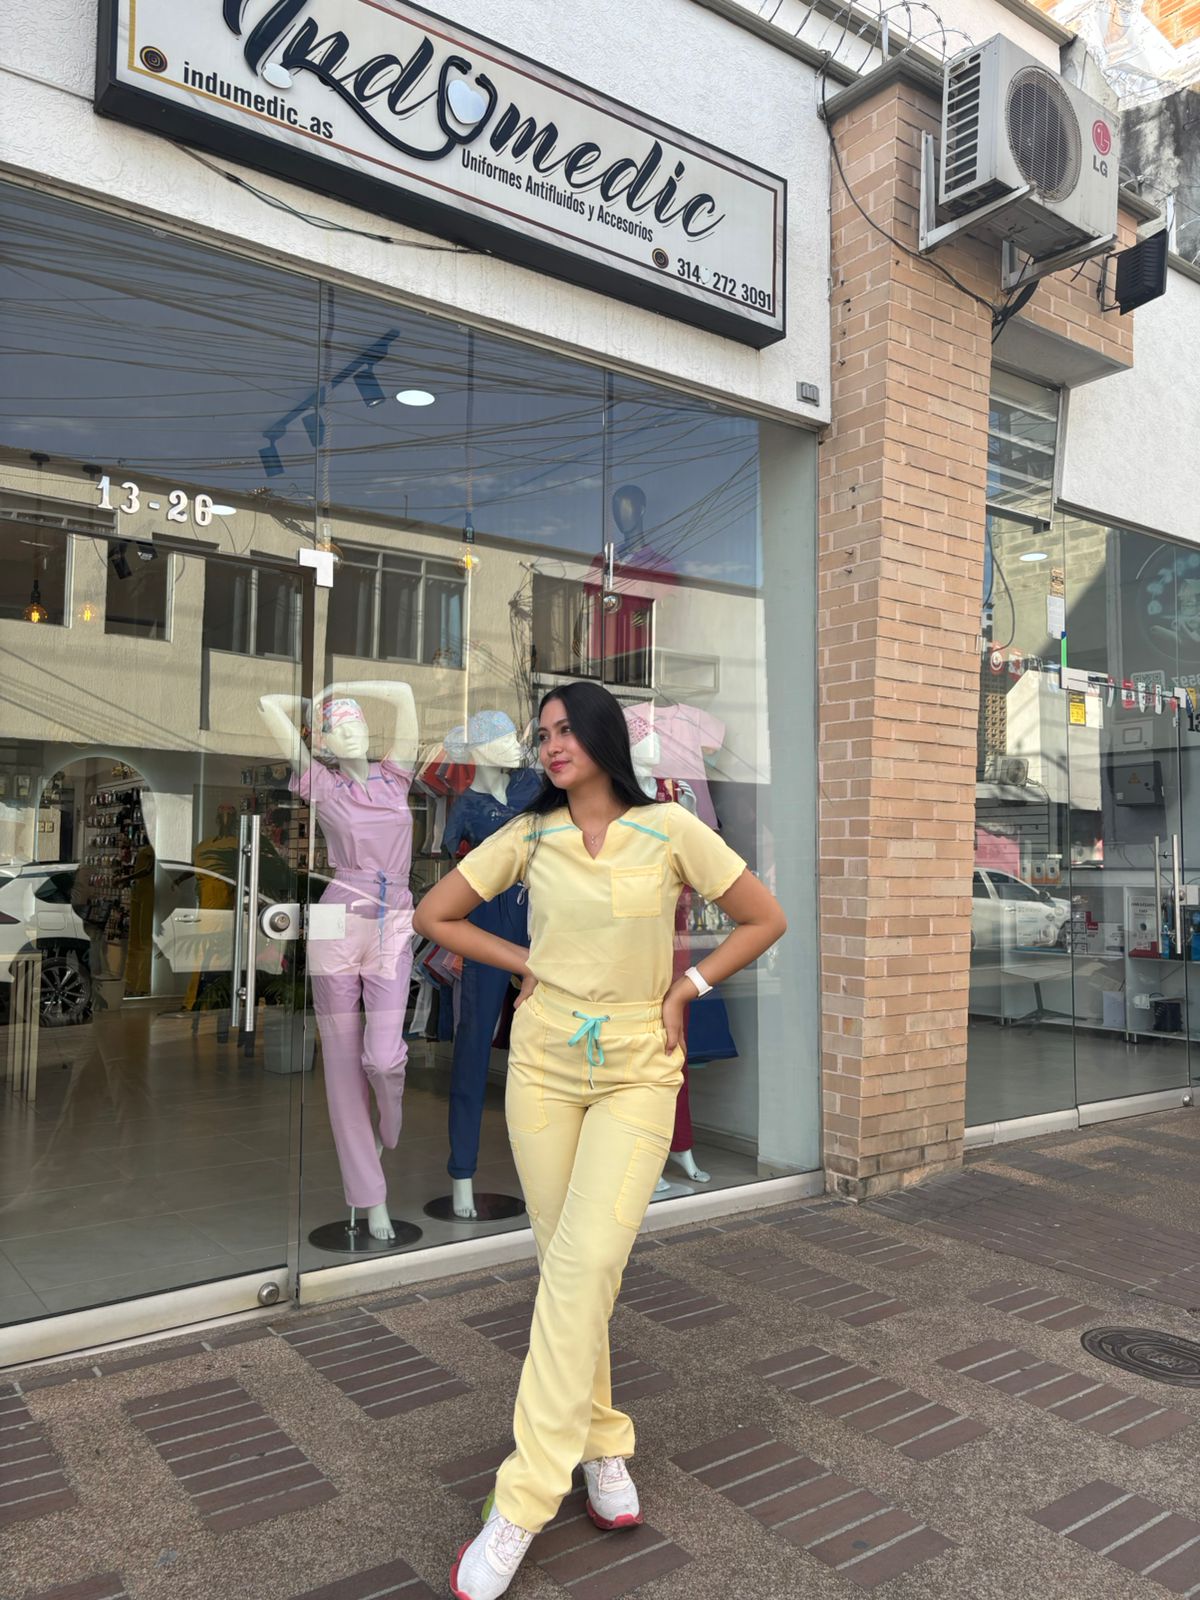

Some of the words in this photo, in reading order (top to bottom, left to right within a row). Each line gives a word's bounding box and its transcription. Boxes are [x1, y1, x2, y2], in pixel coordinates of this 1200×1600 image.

[183, 61, 333, 139] indumedic_as
[461, 148, 522, 190] Uniformes
[525, 175, 585, 215] Antifluidos
[587, 204, 595, 221] y
[597, 205, 654, 242] Accesorios
[1093, 155, 1108, 178] LG
[677, 258, 700, 282] 314
[713, 272, 737, 297] 272
[741, 283, 771, 310] 3091
